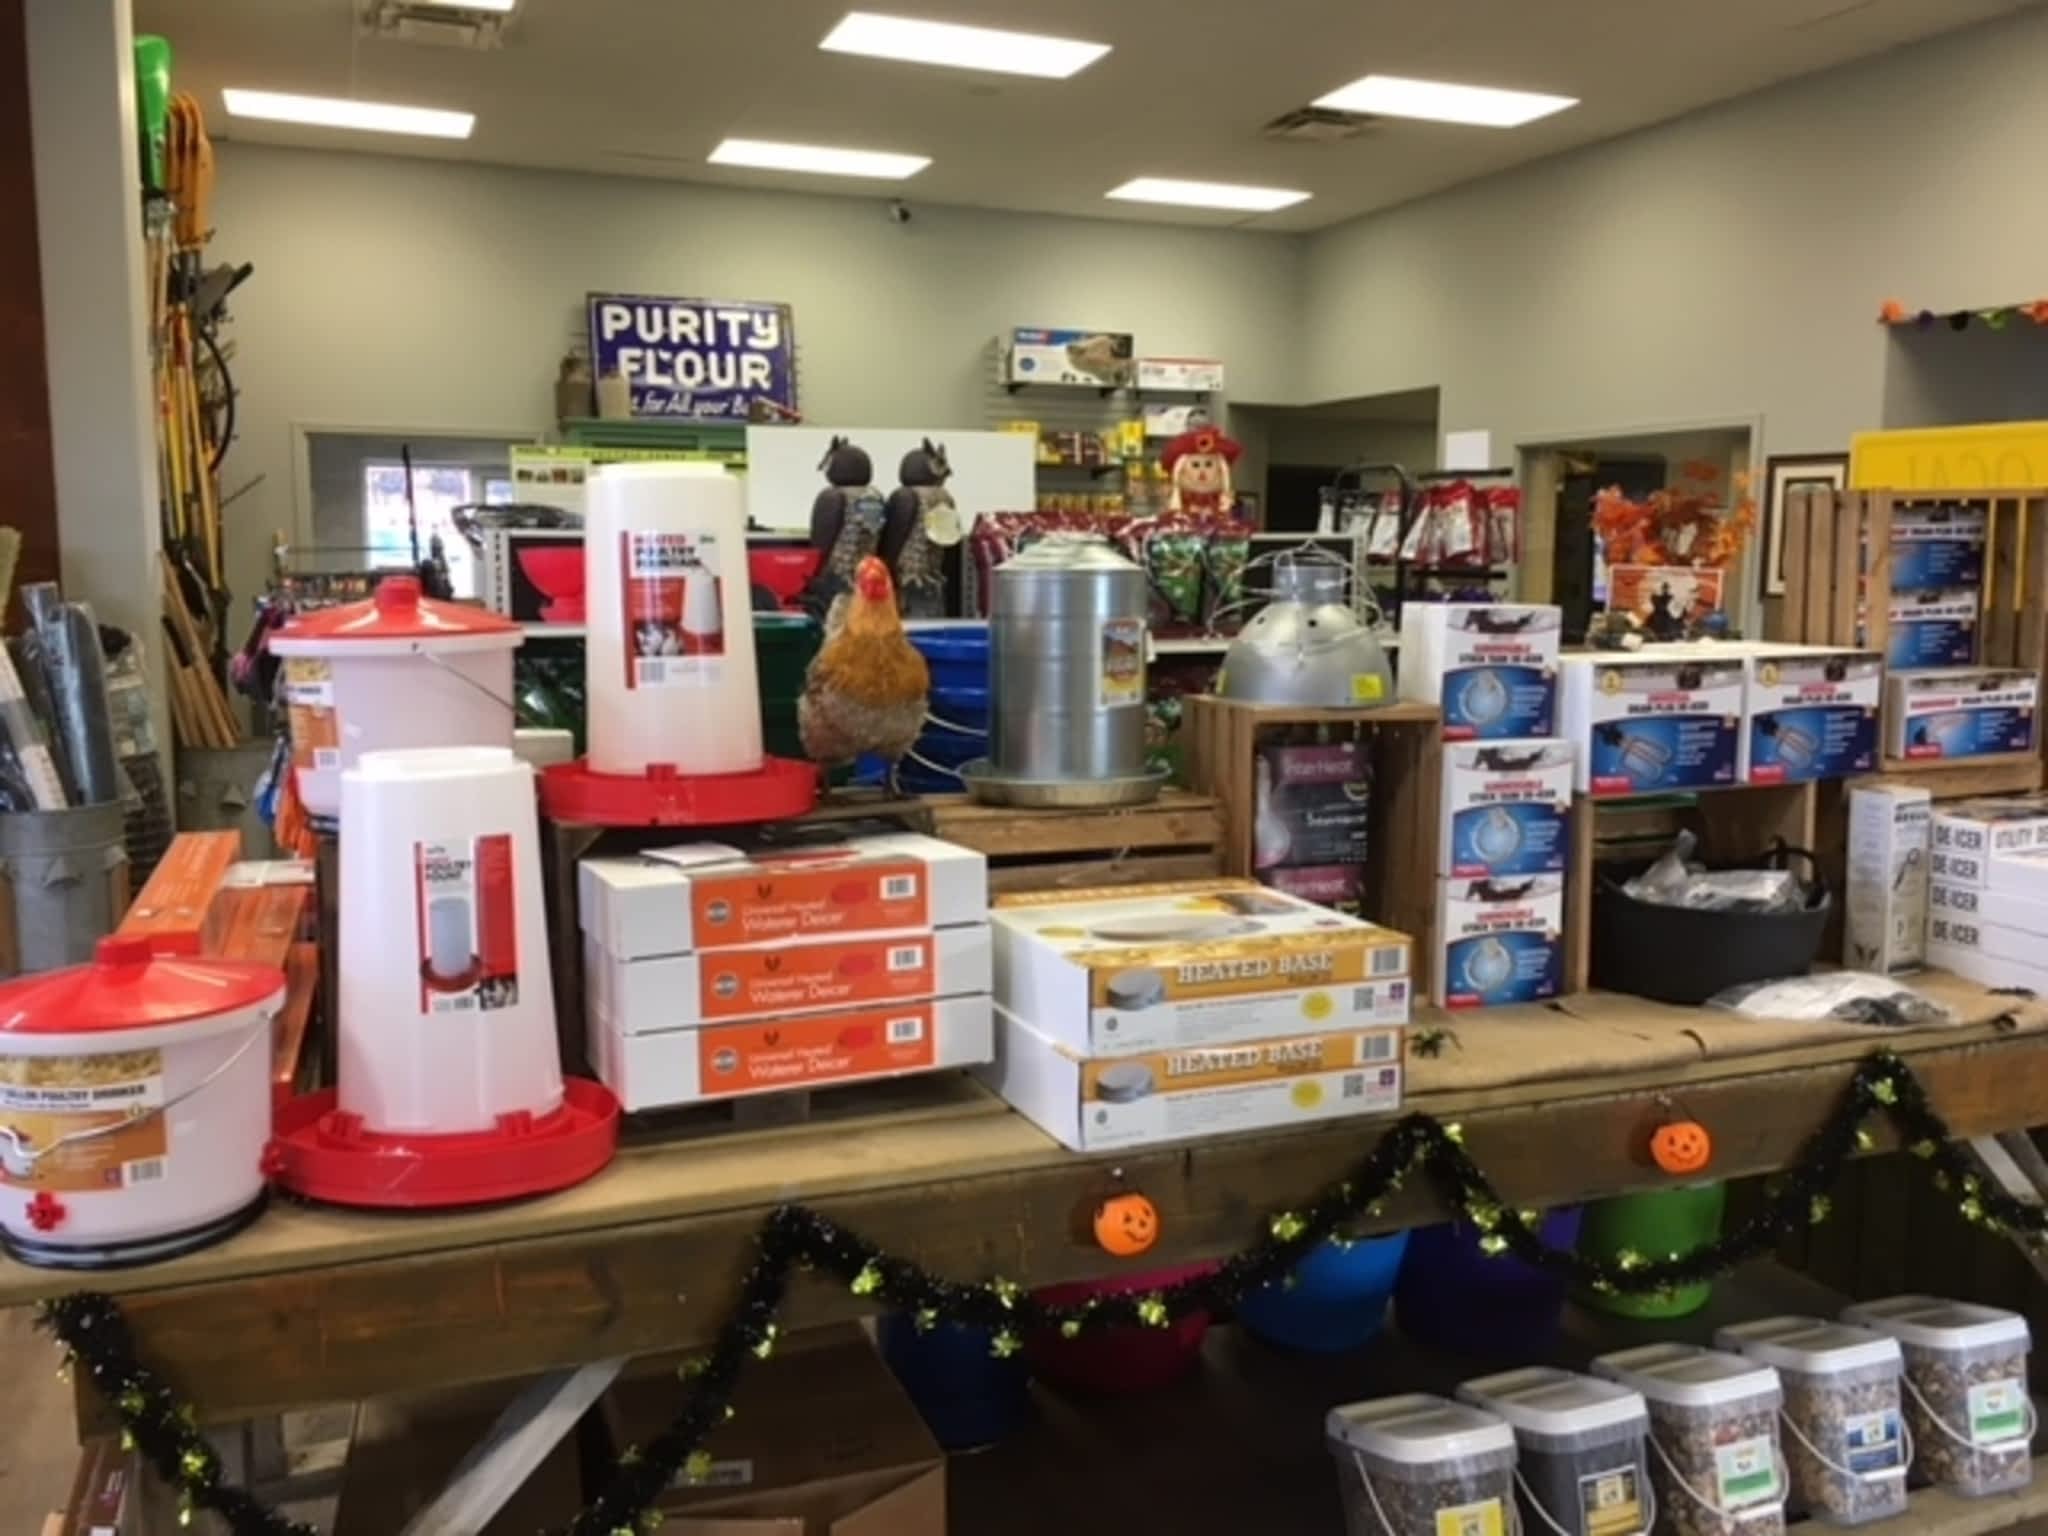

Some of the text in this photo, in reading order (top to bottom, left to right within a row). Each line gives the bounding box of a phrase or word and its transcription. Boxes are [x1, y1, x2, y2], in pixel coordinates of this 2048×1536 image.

[602, 304, 780, 349] PURITY
[618, 348, 772, 390] FLOUR
[1954, 828, 1982, 850] ICER
[1950, 858, 1979, 880] ICER
[1950, 890, 1979, 912] ICER
[1950, 924, 1979, 945] ICER
[1177, 959, 1272, 984] HEATED
[1278, 951, 1335, 975] BASE
[1166, 1050, 1262, 1077] HEATED
[1266, 1041, 1324, 1065] BASE
